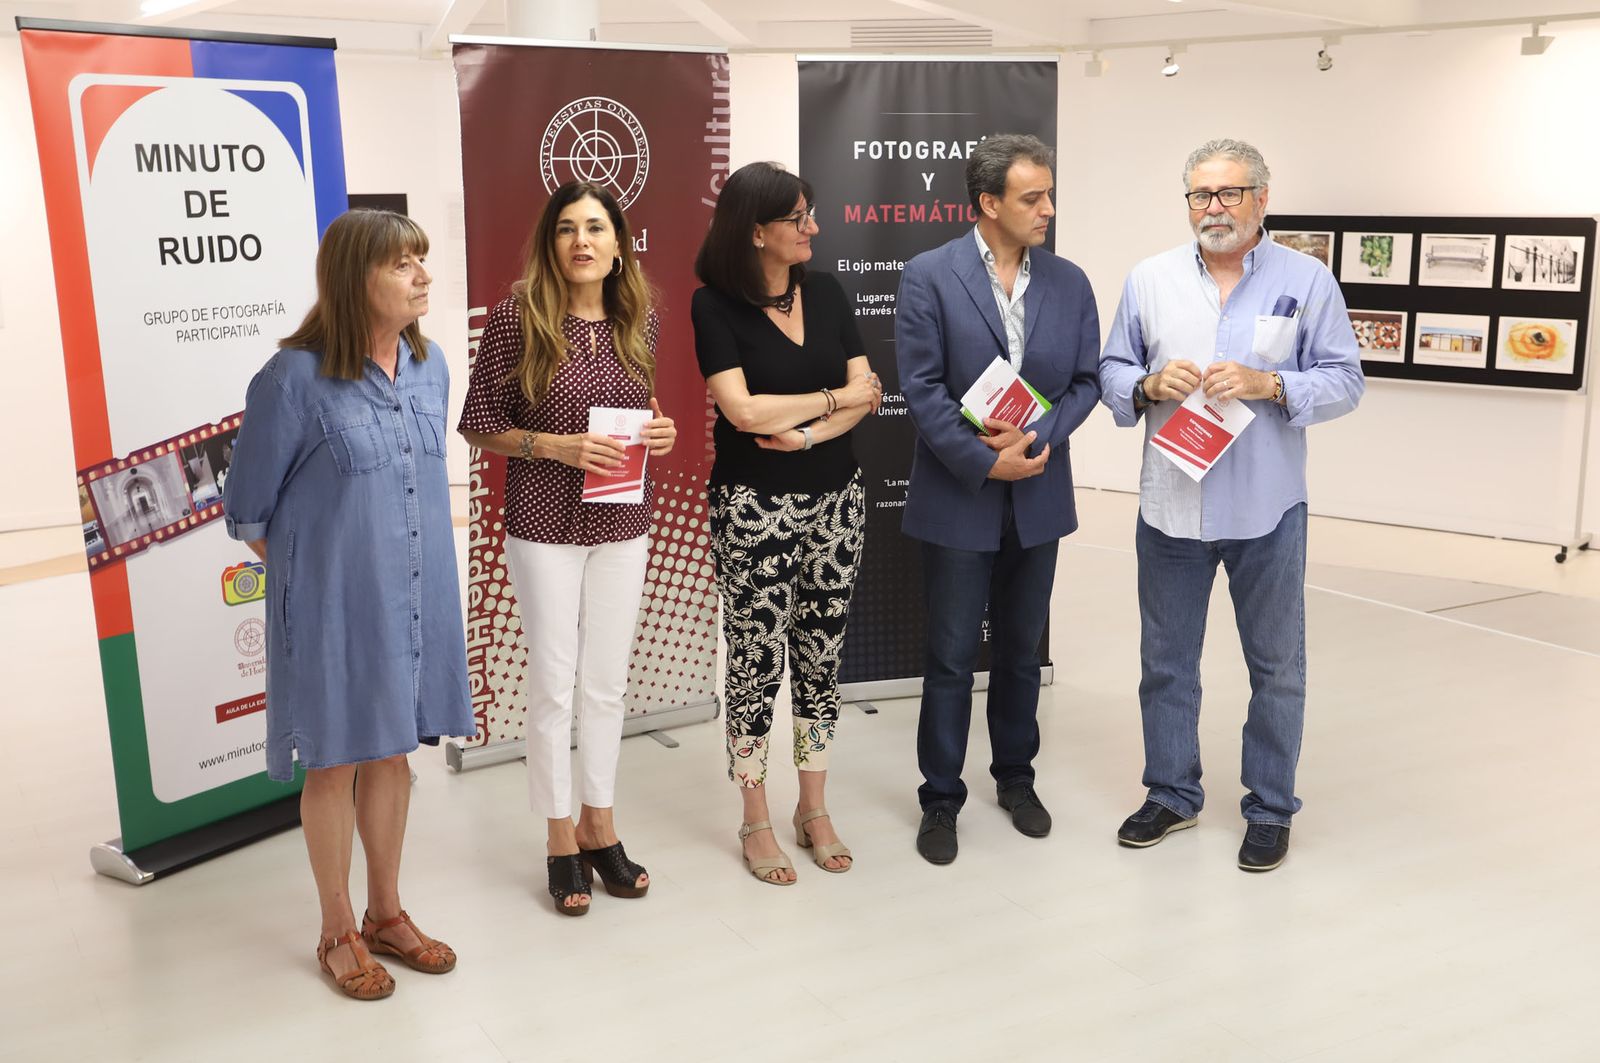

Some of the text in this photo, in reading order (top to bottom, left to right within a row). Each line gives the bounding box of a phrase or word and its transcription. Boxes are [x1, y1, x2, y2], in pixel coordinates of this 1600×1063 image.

[853, 135, 987, 160] FOTOGRAF
[134, 143, 265, 173] MINUTO
[921, 172, 935, 191] Y
[184, 189, 230, 219] DE
[844, 199, 978, 224] MATEMÁTIC
[158, 233, 262, 266] RUIDO
[837, 259, 907, 274] El ojo mate
[856, 293, 895, 304] Lugares
[143, 299, 286, 326] GRUPO DE FOTOGRAFÍA
[855, 308, 861, 316] a
[862, 305, 892, 316] través
[176, 323, 260, 343] PARTICIPATIVA
[877, 406, 908, 416] Univer
[225, 705, 240, 715] AULA
[240, 703, 248, 711] DE
